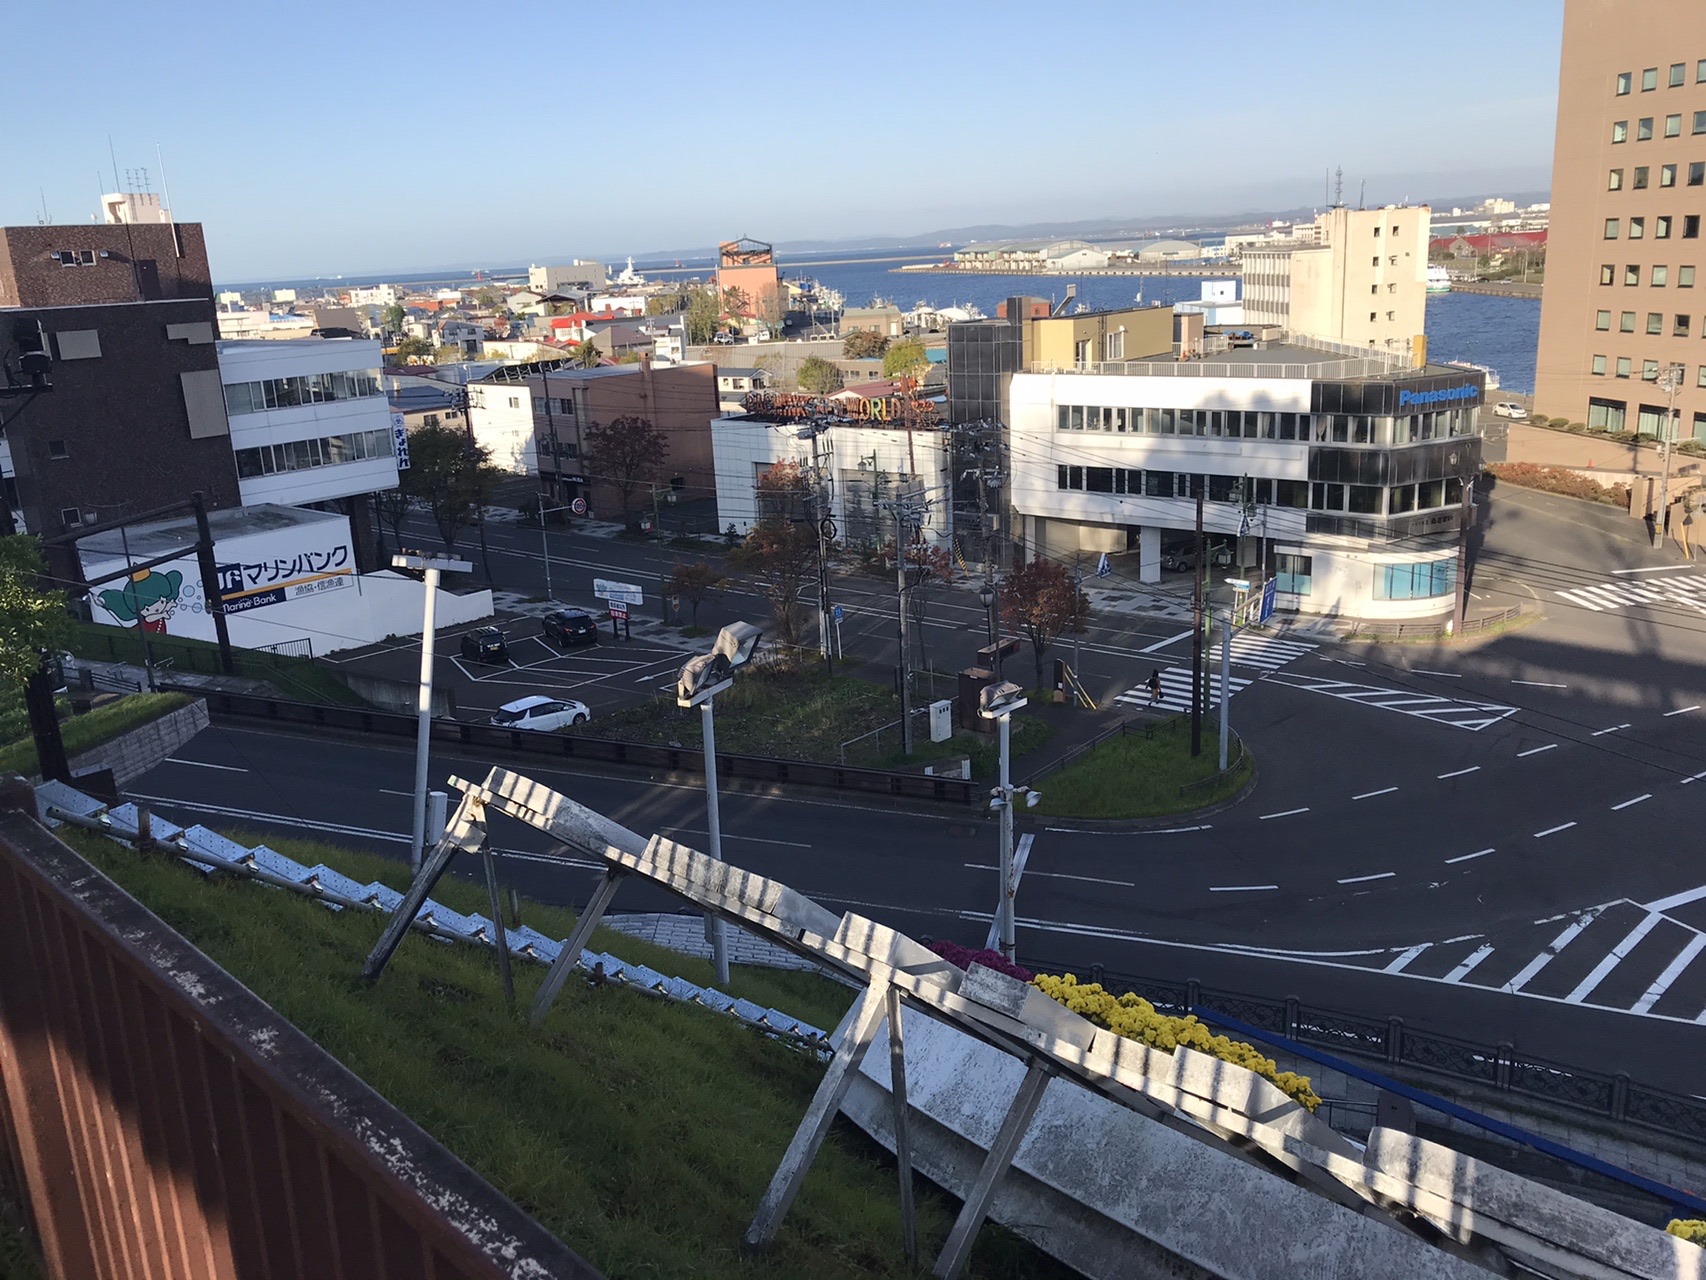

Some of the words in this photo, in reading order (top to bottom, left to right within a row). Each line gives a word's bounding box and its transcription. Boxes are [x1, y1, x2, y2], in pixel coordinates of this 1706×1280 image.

[1400, 383, 1479, 406] Panasonic
[845, 396, 902, 421] WORLD
[394, 428, 409, 468] ぎょれん
[243, 545, 348, 585] マリンバンク
[253, 593, 277, 606] Bank
